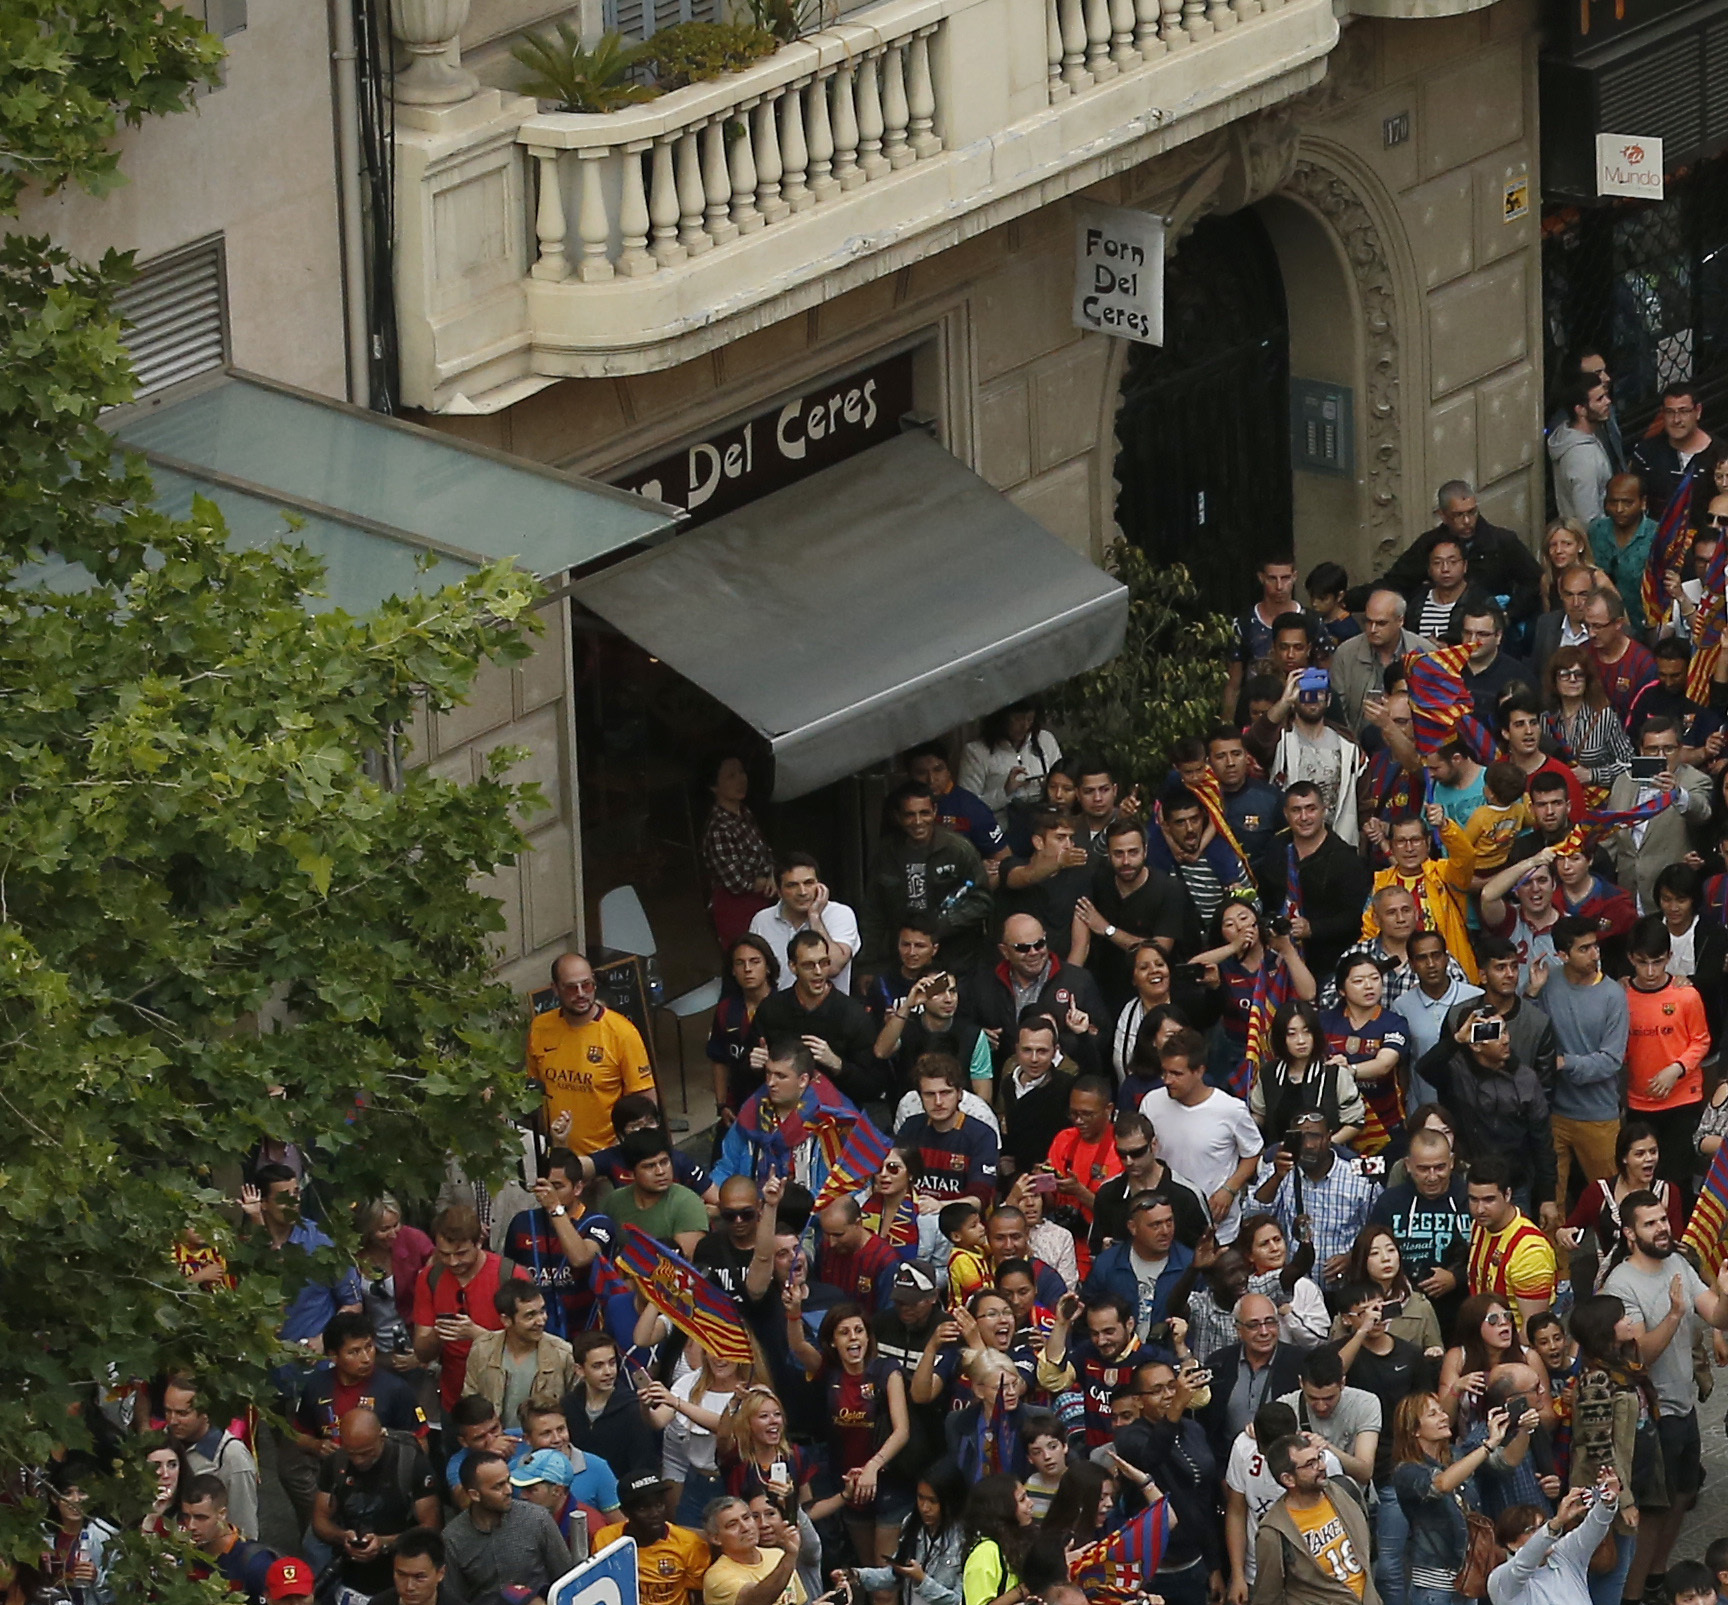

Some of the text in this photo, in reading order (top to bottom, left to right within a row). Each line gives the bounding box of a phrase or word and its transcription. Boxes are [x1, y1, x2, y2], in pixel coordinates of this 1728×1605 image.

[1604, 166, 1661, 186] Mundo
[1086, 228, 1145, 267] Forn
[1094, 264, 1138, 295] Del
[1083, 297, 1150, 337] Ceres
[687, 378, 878, 512] Del Ceres
[545, 1067, 593, 1085] QATAR
[1248, 1455, 1263, 1477] 3
